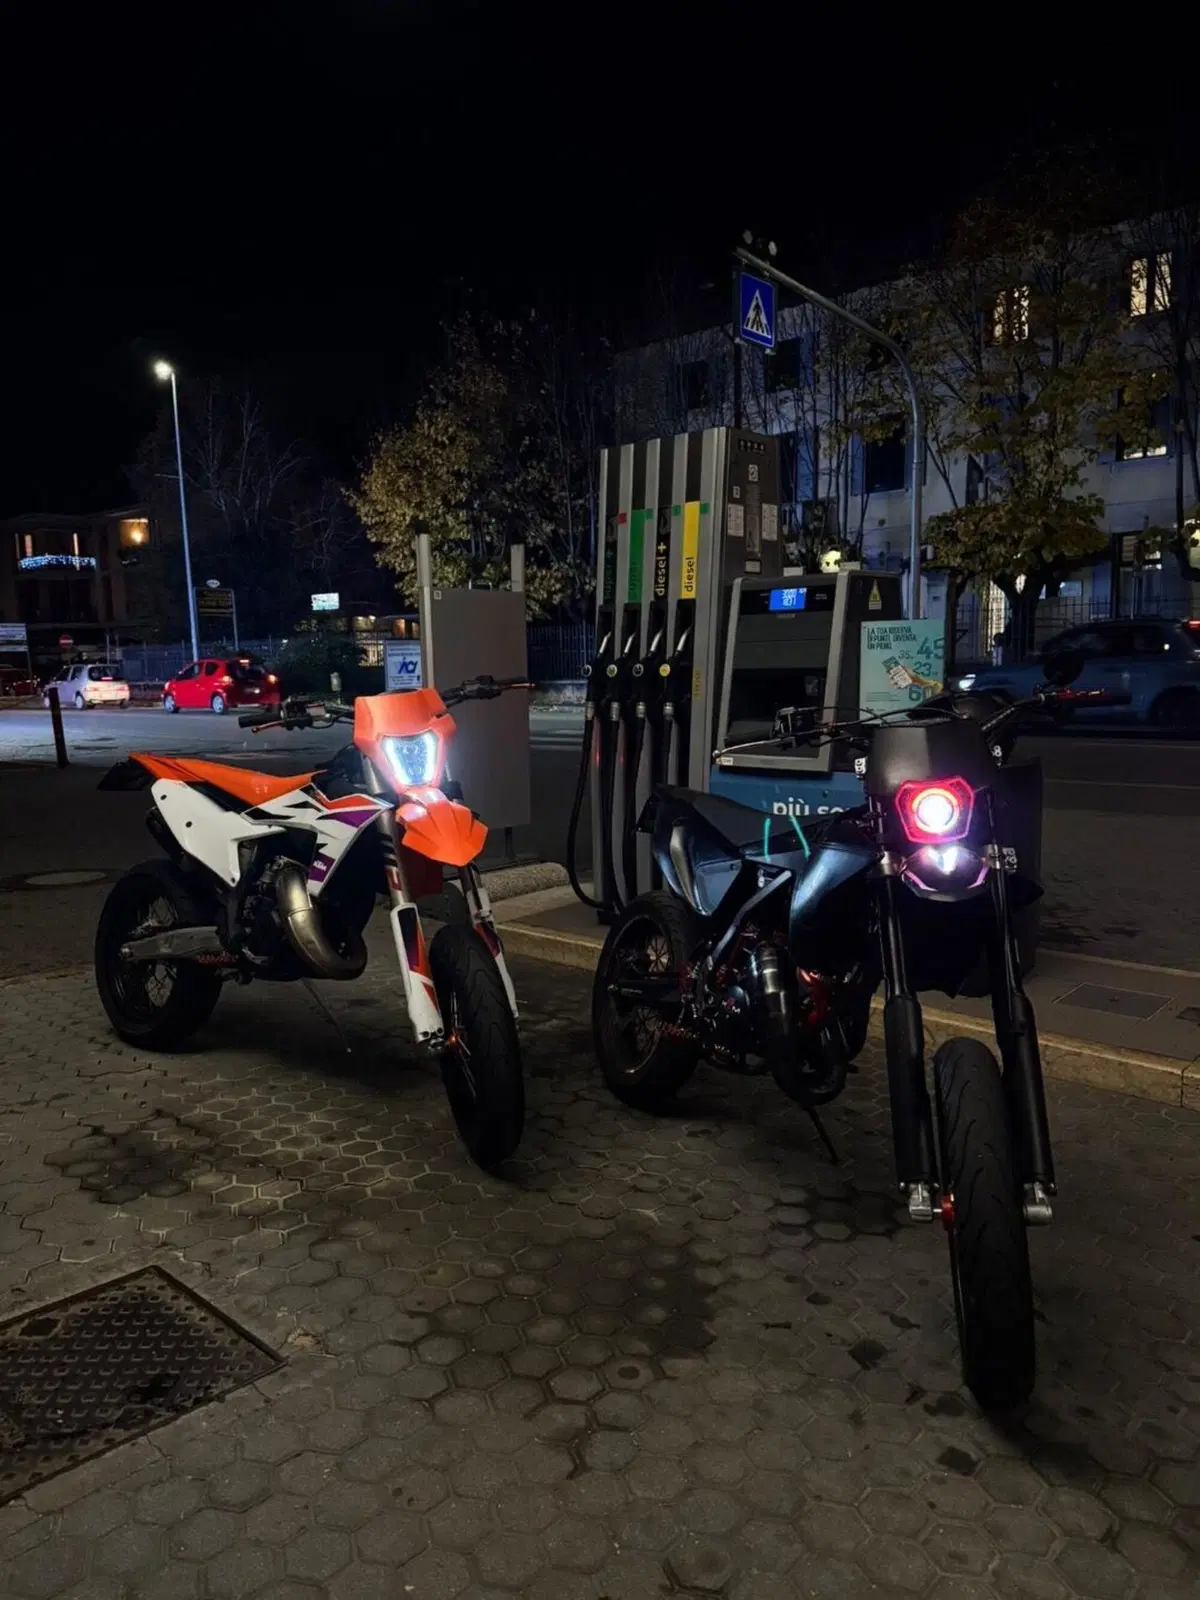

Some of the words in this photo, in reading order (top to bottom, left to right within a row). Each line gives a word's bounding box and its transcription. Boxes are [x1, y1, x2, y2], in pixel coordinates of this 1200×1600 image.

[655, 556, 667, 596] diesel
[684, 556, 694, 592] diesel
[772, 796, 810, 816] più
